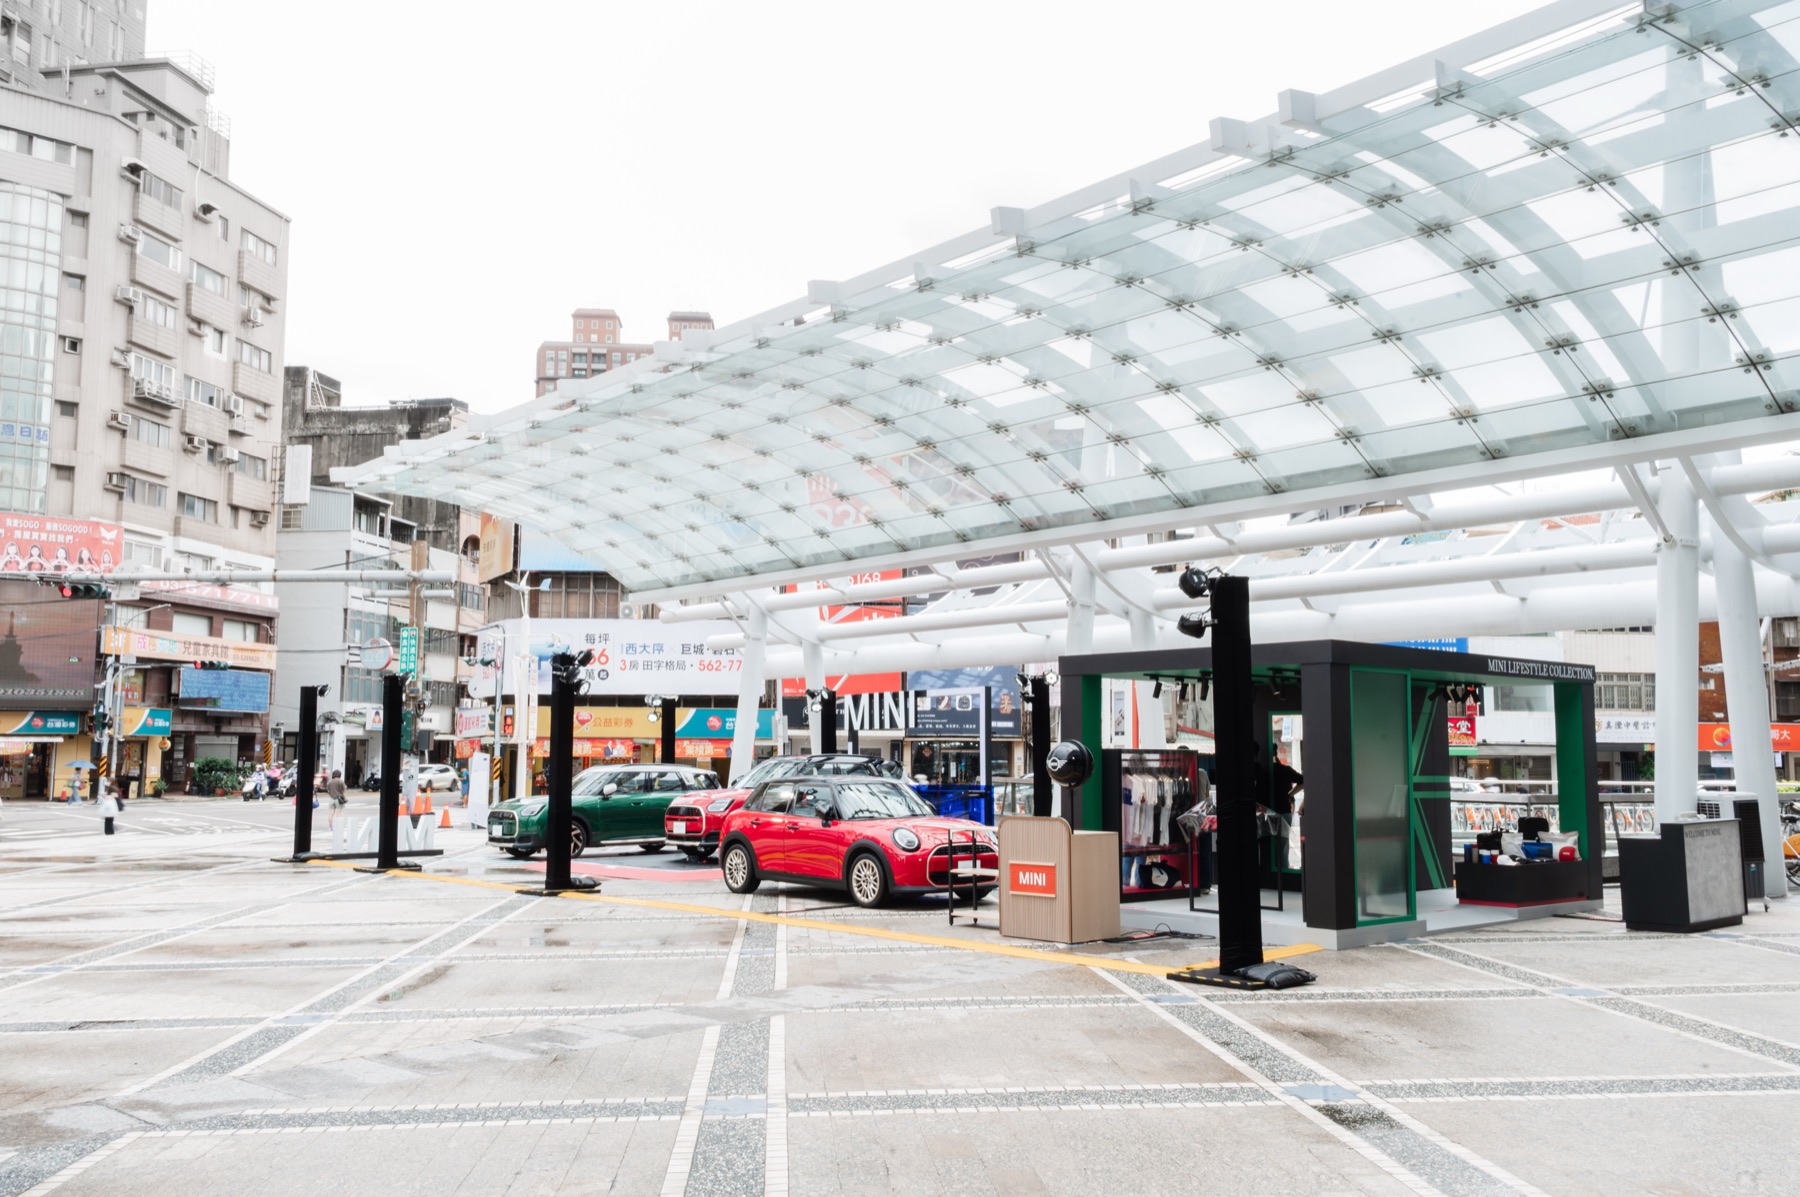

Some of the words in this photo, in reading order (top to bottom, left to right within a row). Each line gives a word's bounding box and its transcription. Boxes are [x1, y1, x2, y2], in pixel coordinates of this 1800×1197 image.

[1488, 658, 1507, 673] MINI
[1508, 661, 1548, 676] LIFESTYLE
[1549, 664, 1595, 680] COLLECTION.
[844, 690, 915, 732] MINI
[1019, 871, 1046, 887] MINI
